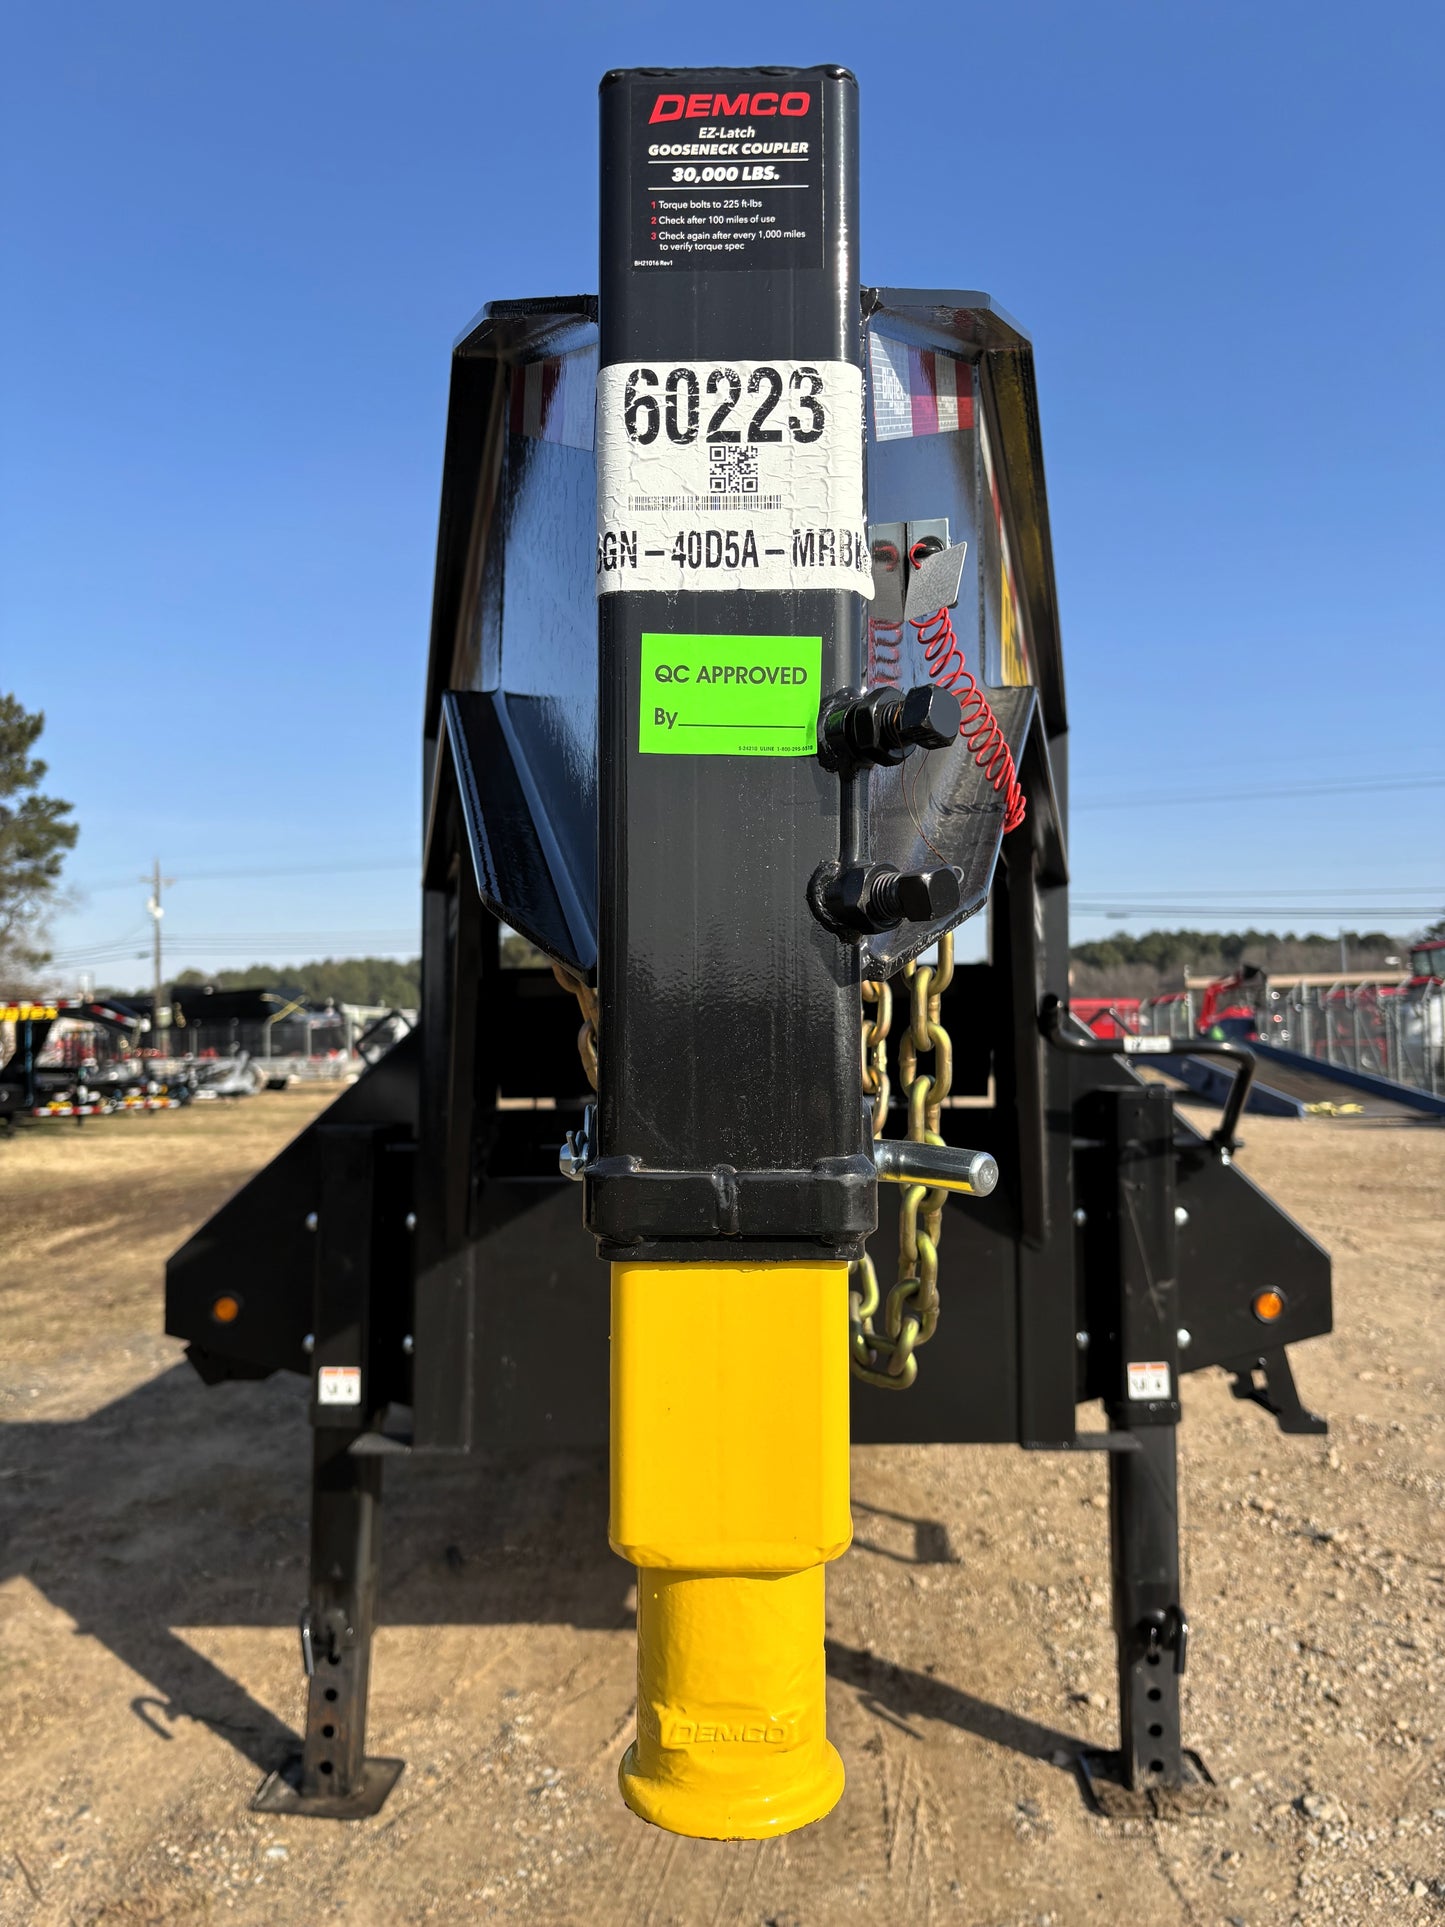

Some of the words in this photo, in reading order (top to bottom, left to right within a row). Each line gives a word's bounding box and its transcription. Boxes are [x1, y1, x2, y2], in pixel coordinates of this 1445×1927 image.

[648, 92, 811, 125] DEMCO
[698, 126, 756, 139] EZ-Latch
[648, 144, 739, 156] GOOSENECK
[741, 142, 809, 155] COUPLER
[671, 167, 739, 183] 30,000
[741, 165, 780, 181] LBS.
[651, 201, 656, 209] 1
[658, 201, 688, 211] Torque
[690, 200, 711, 209] bolts
[713, 201, 722, 209] to
[723, 200, 740, 209] 225
[741, 199, 763, 208] ft-lbs
[651, 216, 657, 225] 2
[658, 216, 685, 225] Check
[687, 215, 706, 225] after
[708, 215, 724, 224] 100
[726, 215, 749, 224] miles
[750, 214, 760, 223] of
[651, 232, 657, 240] 3
[658, 231, 685, 240] Check
[687, 232, 710, 242] again
[712, 231, 731, 240] after
[733, 232, 756, 241] every
[758, 229, 782, 239] 1,000
[783, 229, 806, 238] miles
[670, 242, 693, 252] verify
[694, 243, 723, 252] torque
[724, 243, 745, 252] spec
[624, 366, 825, 445] 60223
[654, 664, 690, 683] QC
[696, 666, 807, 685] APPROVED
[654, 707, 678, 729] By
[669, 1722, 787, 1745] DEMCO
